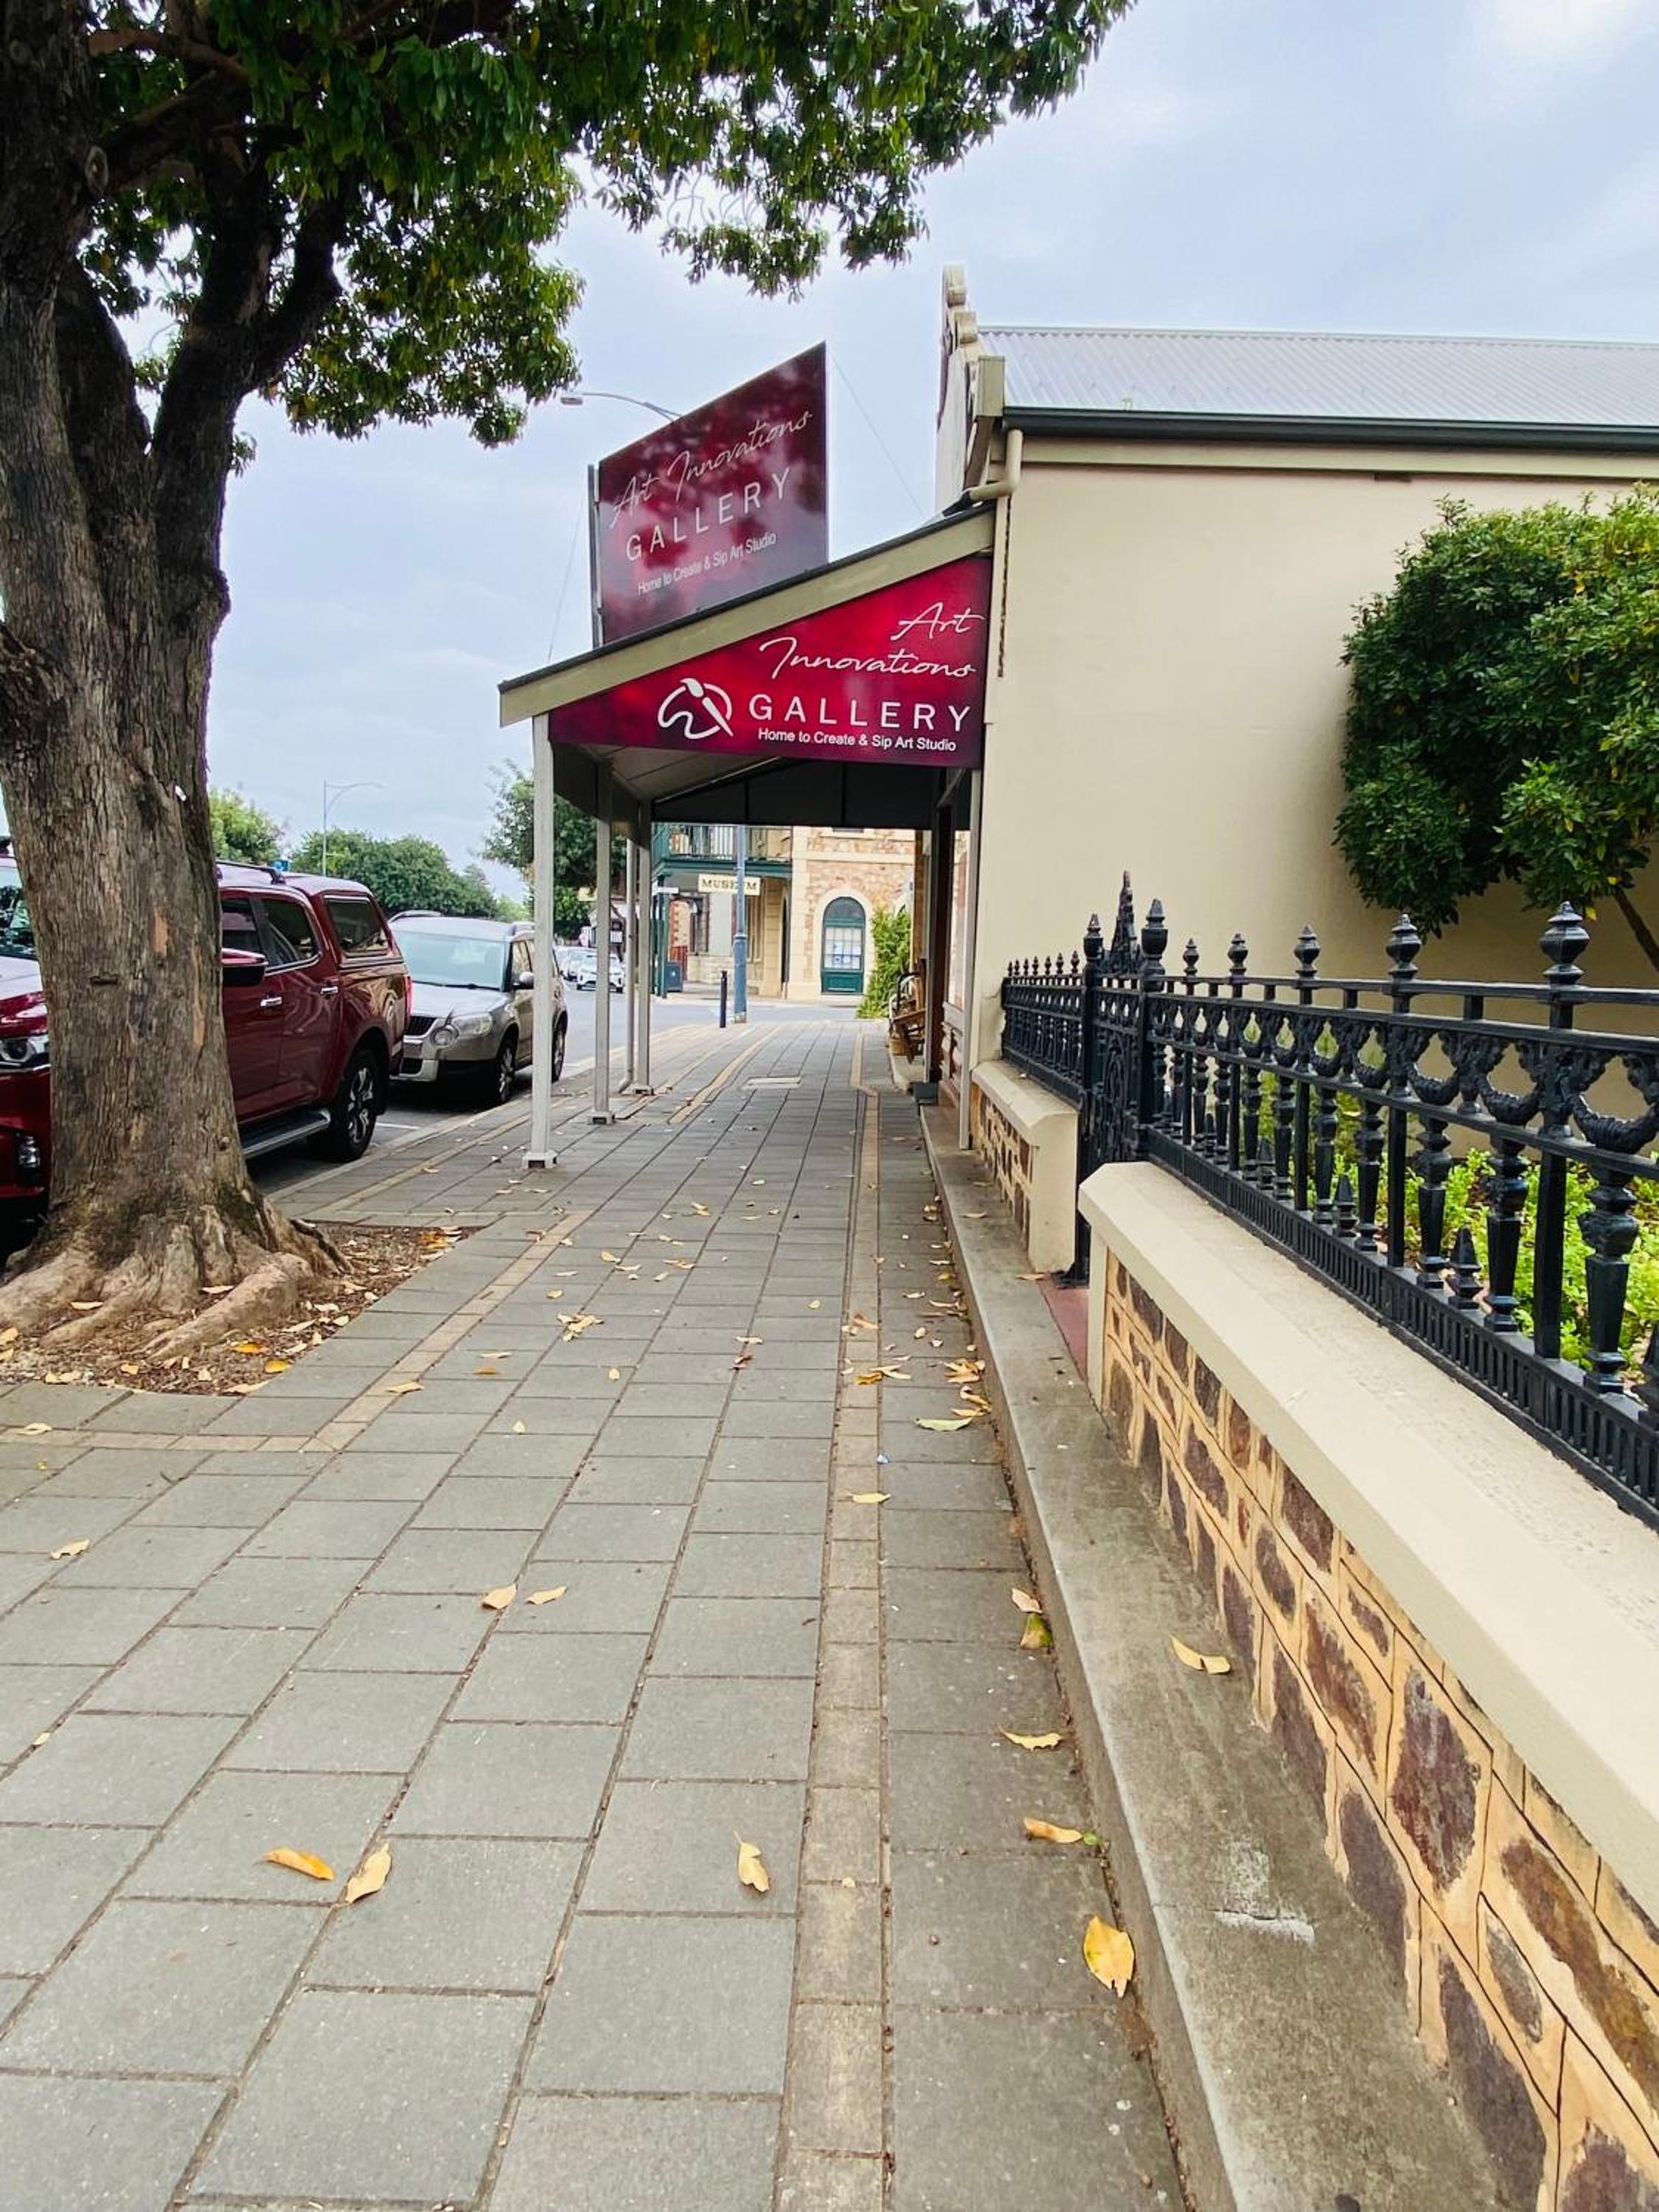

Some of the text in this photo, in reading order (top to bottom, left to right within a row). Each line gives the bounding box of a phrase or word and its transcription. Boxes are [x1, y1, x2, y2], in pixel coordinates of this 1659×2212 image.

[610, 411, 813, 529] Art Innovations
[627, 467, 790, 560] GALLERY
[638, 577, 661, 596] Home
[713, 551, 728, 568] Sip
[730, 544, 743, 560] Art
[745, 532, 776, 554] Studio
[891, 602, 985, 641] Art
[759, 636, 977, 679] Innovations
[748, 694, 970, 732] GALLERY
[758, 728, 956, 751] Home to Create & Sip Art Studio
[702, 878, 757, 890] MUSEM
